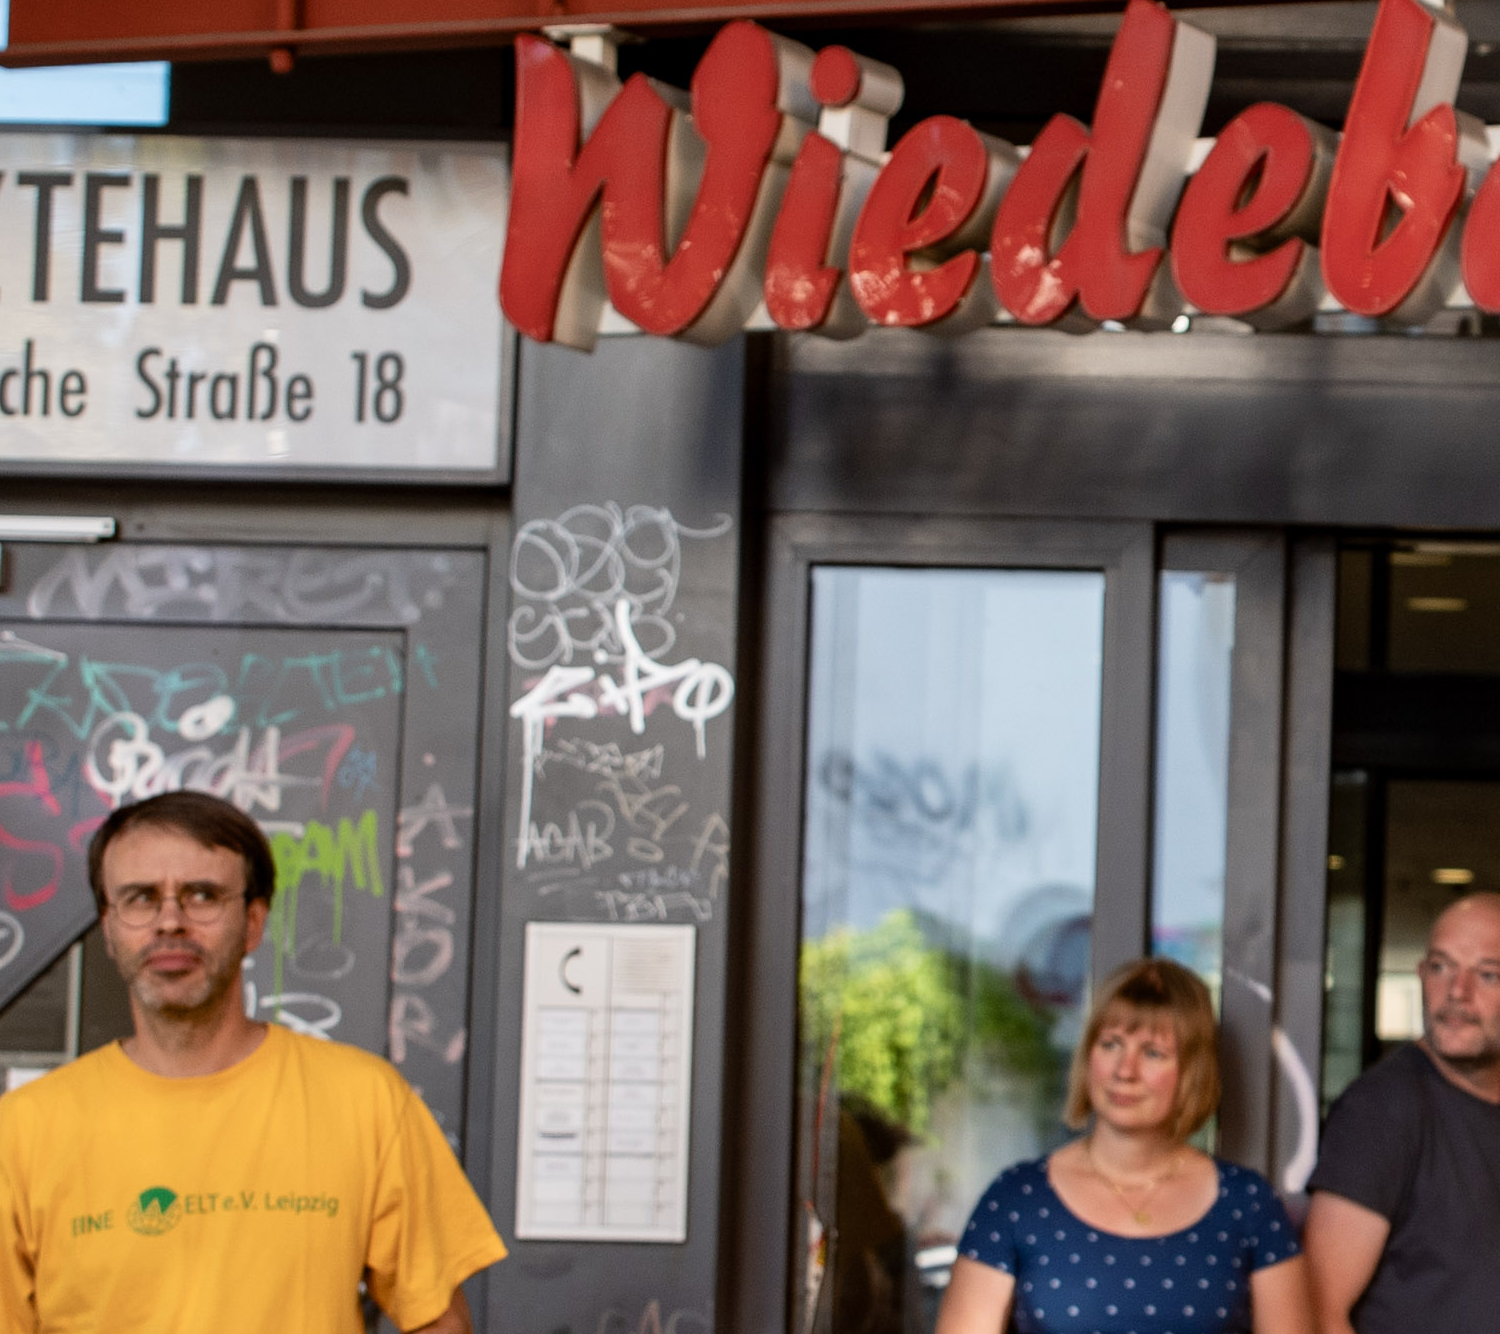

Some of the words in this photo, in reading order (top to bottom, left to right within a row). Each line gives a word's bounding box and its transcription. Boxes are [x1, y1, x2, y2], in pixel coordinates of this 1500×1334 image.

[135, 346, 314, 424] Straße
[350, 350, 407, 426] 18
[264, 1191, 340, 1217] Leipzig
